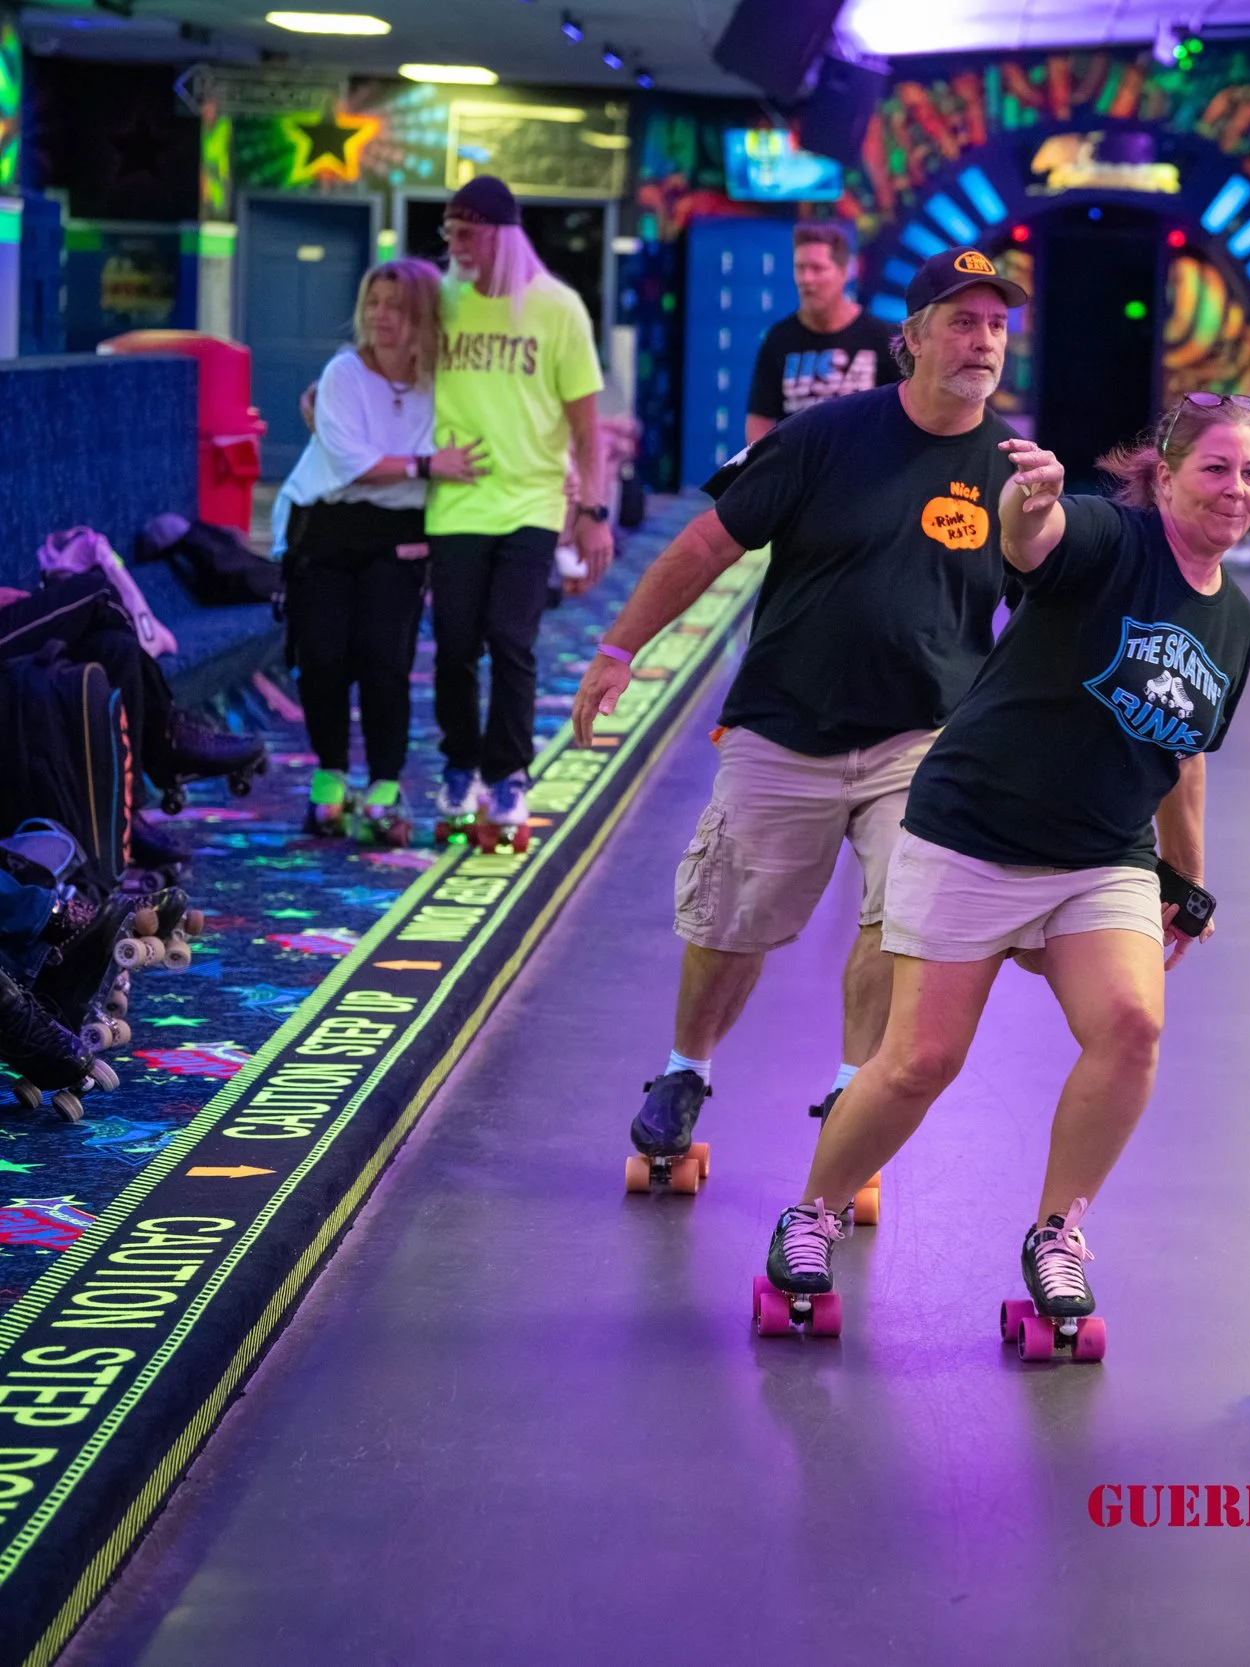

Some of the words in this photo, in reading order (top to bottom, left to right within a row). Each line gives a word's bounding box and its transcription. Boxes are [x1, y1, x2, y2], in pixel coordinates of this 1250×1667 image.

[441, 332, 538, 376] MISFITS
[783, 348, 877, 396] USA
[950, 481, 980, 501] Nick
[935, 512, 965, 527] Rink
[1127, 635, 1163, 665] THE
[1163, 634, 1222, 706] SKATIN'
[1111, 687, 1203, 745] RINK
[336, 990, 417, 1012] UP
[295, 1017, 396, 1056] STEP
[222, 1063, 363, 1139] CAUTION
[51, 1216, 236, 1328] CAUTION
[0, 1346, 137, 1427] STEP
